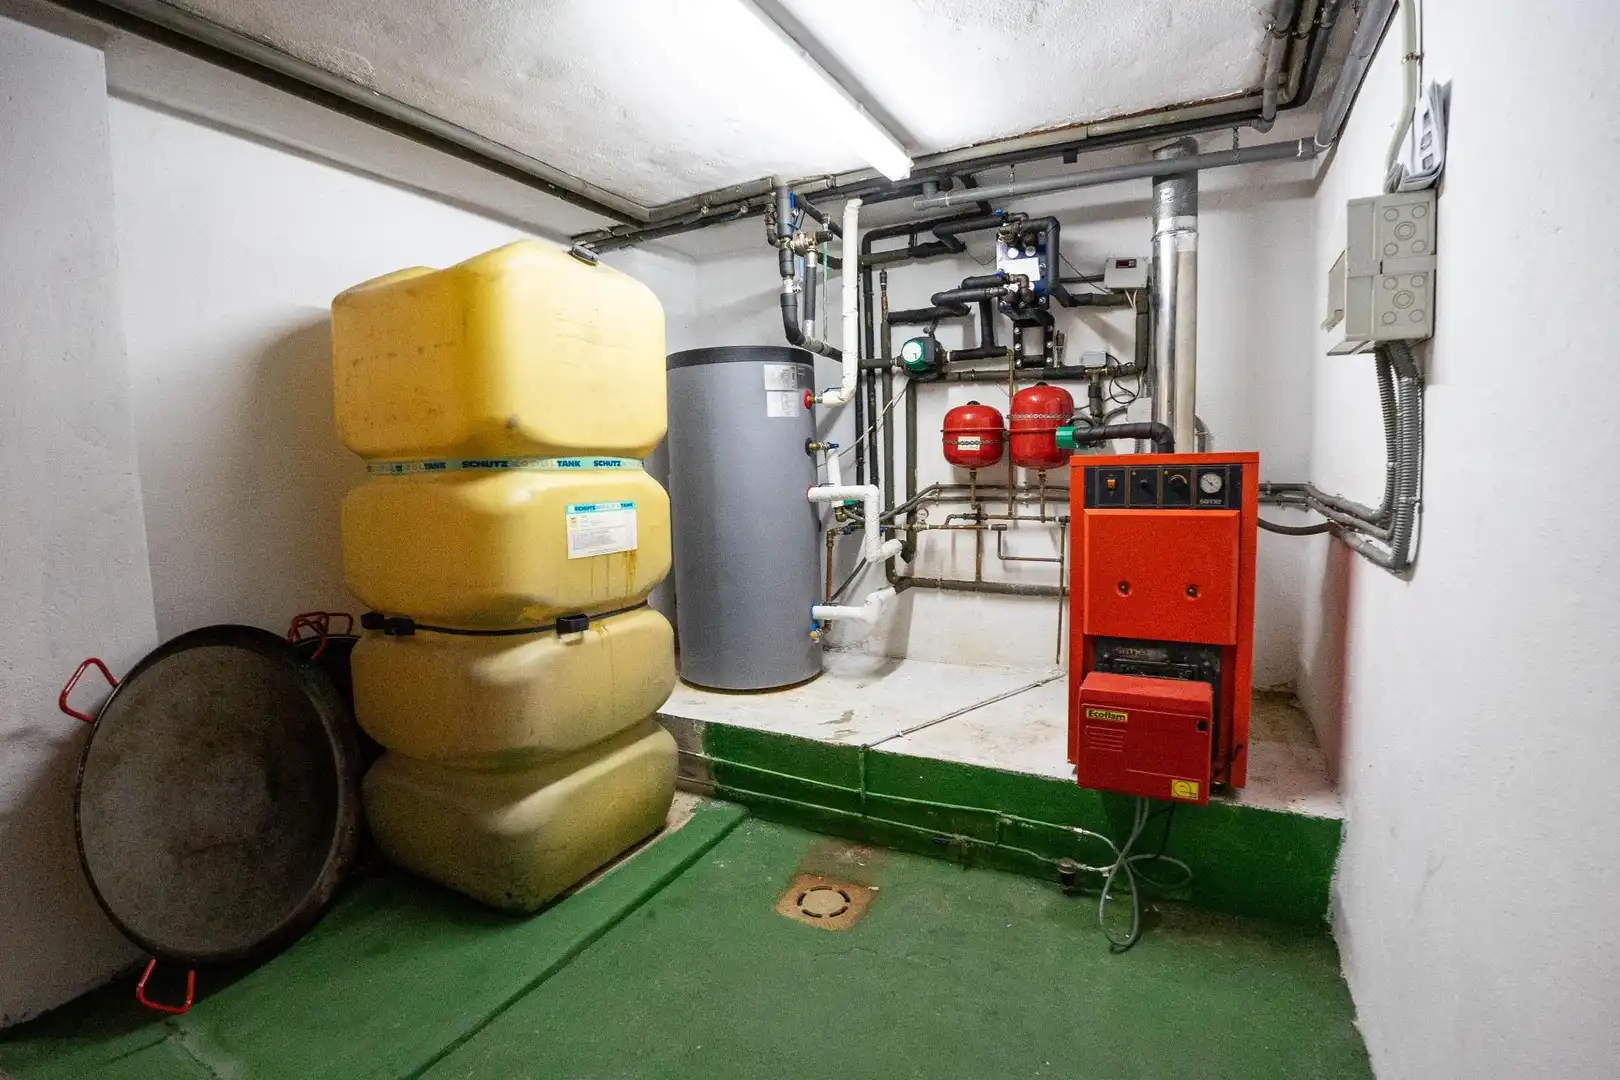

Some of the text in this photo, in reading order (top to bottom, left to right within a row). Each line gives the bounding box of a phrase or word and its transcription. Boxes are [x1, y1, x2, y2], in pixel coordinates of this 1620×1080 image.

[423, 461, 446, 470] TANK
[461, 460, 509, 469] SCHUTZ
[556, 459, 582, 468] TANK
[593, 459, 622, 467] SCHUTZ
[1088, 709, 1126, 720] Ecoflam
